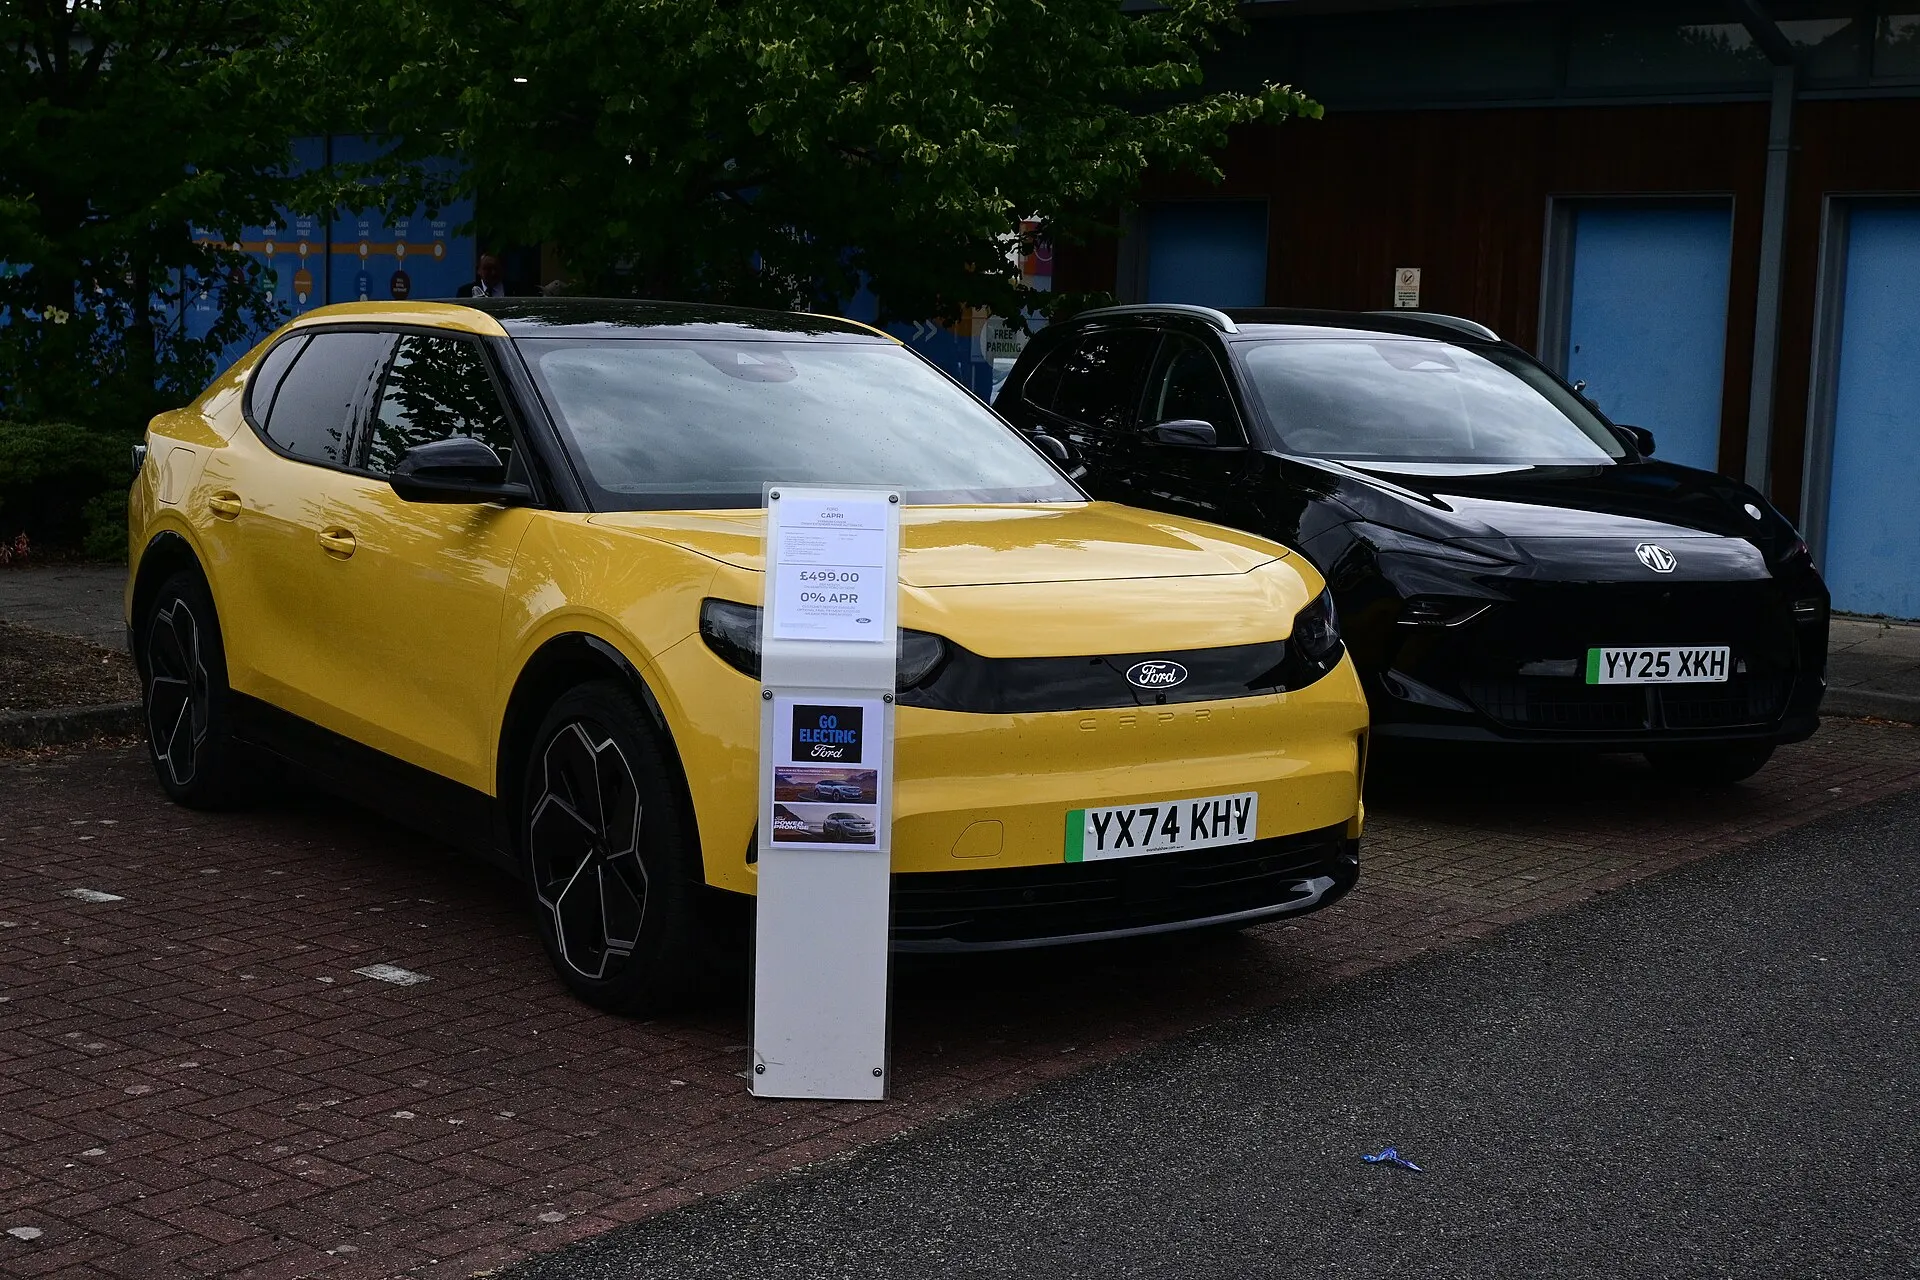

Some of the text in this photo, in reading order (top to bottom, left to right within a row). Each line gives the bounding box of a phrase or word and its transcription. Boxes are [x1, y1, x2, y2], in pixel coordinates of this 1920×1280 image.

[994, 329, 1013, 339] FREE
[987, 342, 1021, 352] PARKING
[1637, 544, 1675, 571] MG
[800, 571, 859, 582] £499.00
[801, 592, 858, 603] 0% APR
[1605, 650, 1725, 678] YY25 XKH
[1138, 663, 1177, 685] Ford
[819, 714, 837, 728] GO
[1079, 706, 1236, 731] CAPRI
[799, 728, 856, 743] ELECTRIC
[810, 743, 844, 758] Ford
[1091, 797, 1252, 850] YX74 KHV
